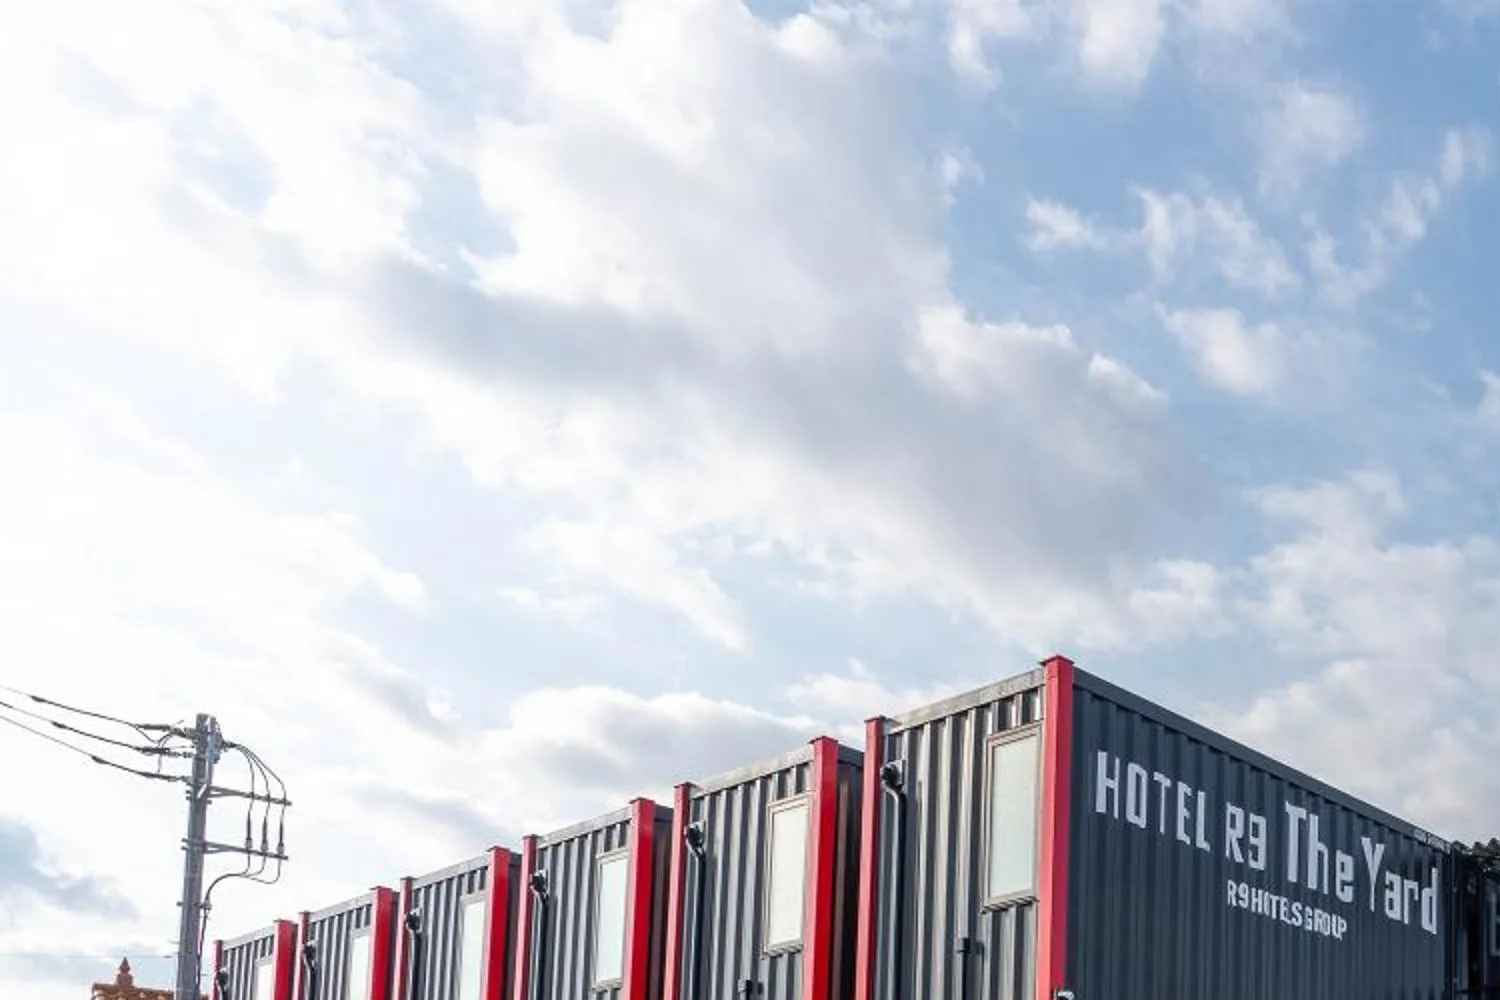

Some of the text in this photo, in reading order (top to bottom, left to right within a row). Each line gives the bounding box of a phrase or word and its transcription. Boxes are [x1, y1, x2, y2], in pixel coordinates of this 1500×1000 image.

[1095, 750, 1439, 935] HOTEL R9 The Yard
[1226, 879, 1249, 909] R9
